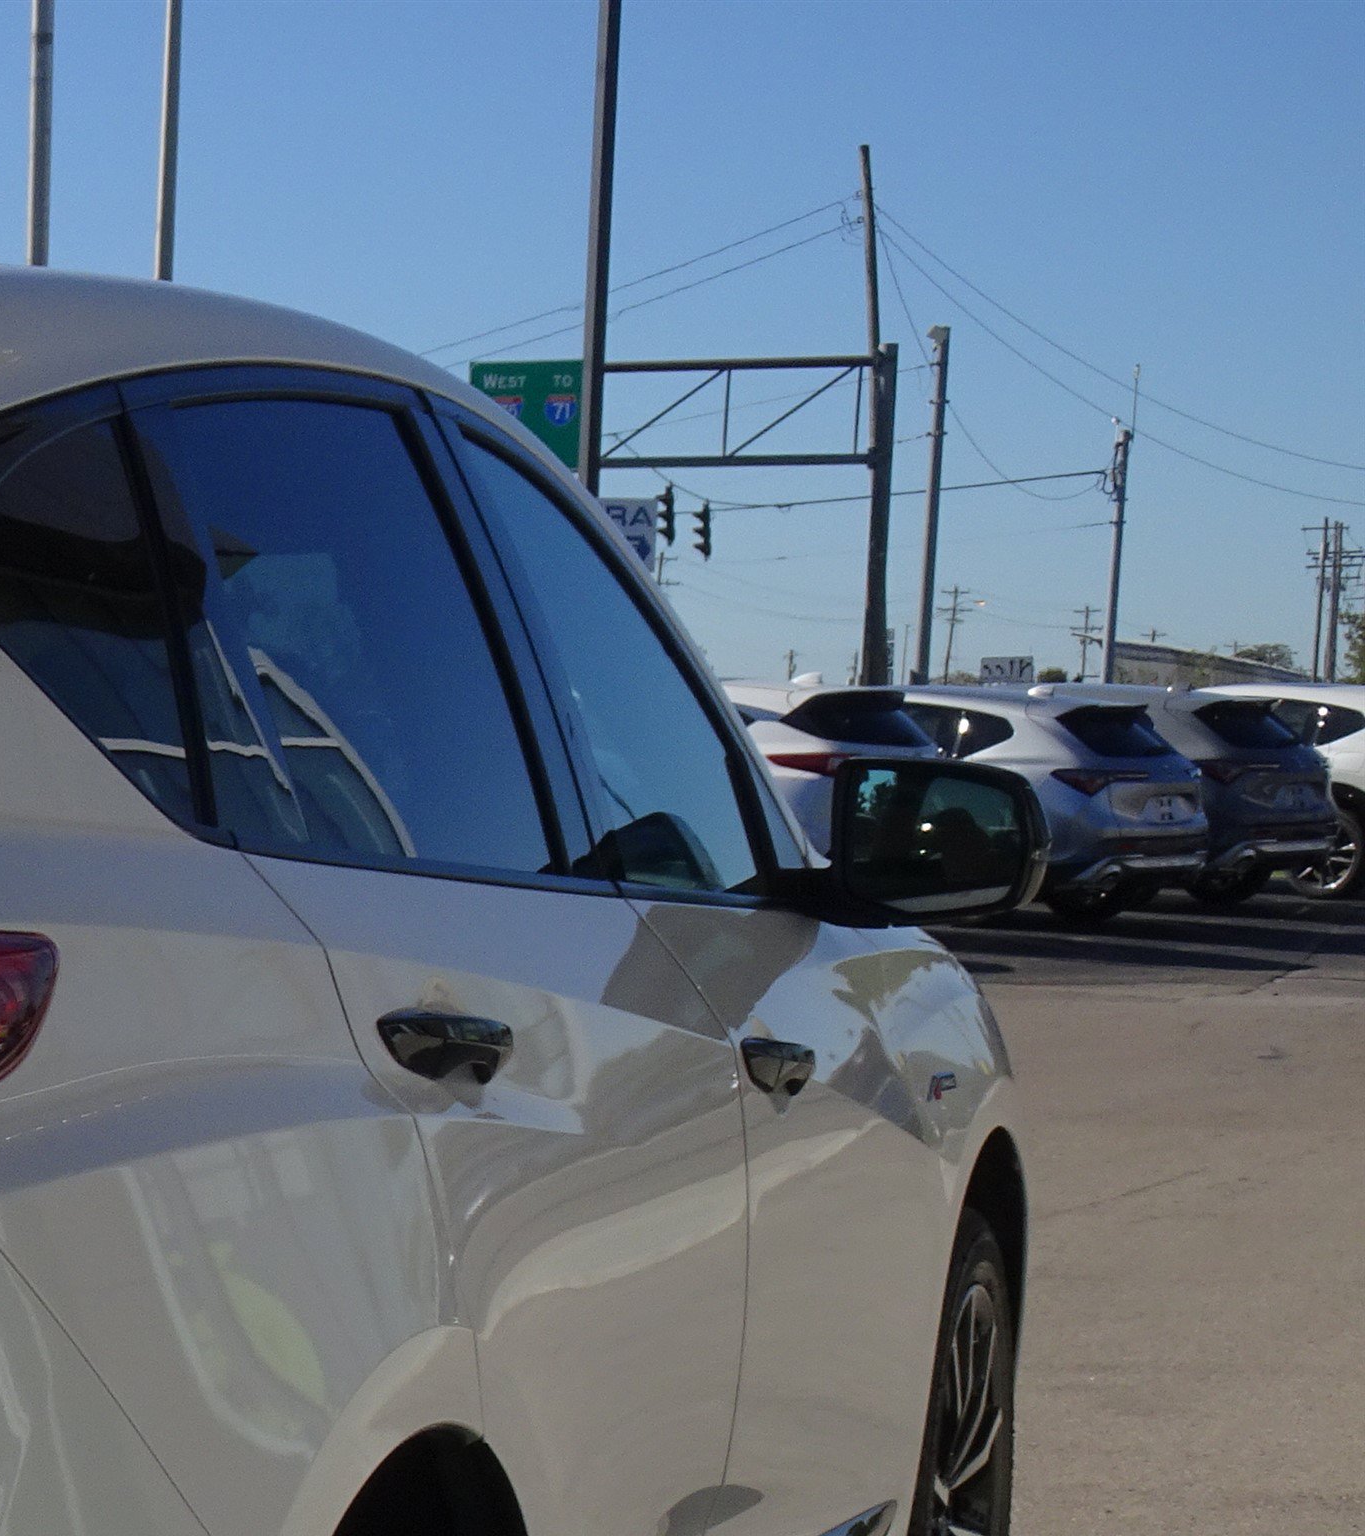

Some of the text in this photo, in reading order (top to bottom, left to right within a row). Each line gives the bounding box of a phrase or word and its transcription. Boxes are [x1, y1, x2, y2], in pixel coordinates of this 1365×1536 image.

[482, 374, 573, 389] WEST TO
[552, 403, 570, 420] 71
